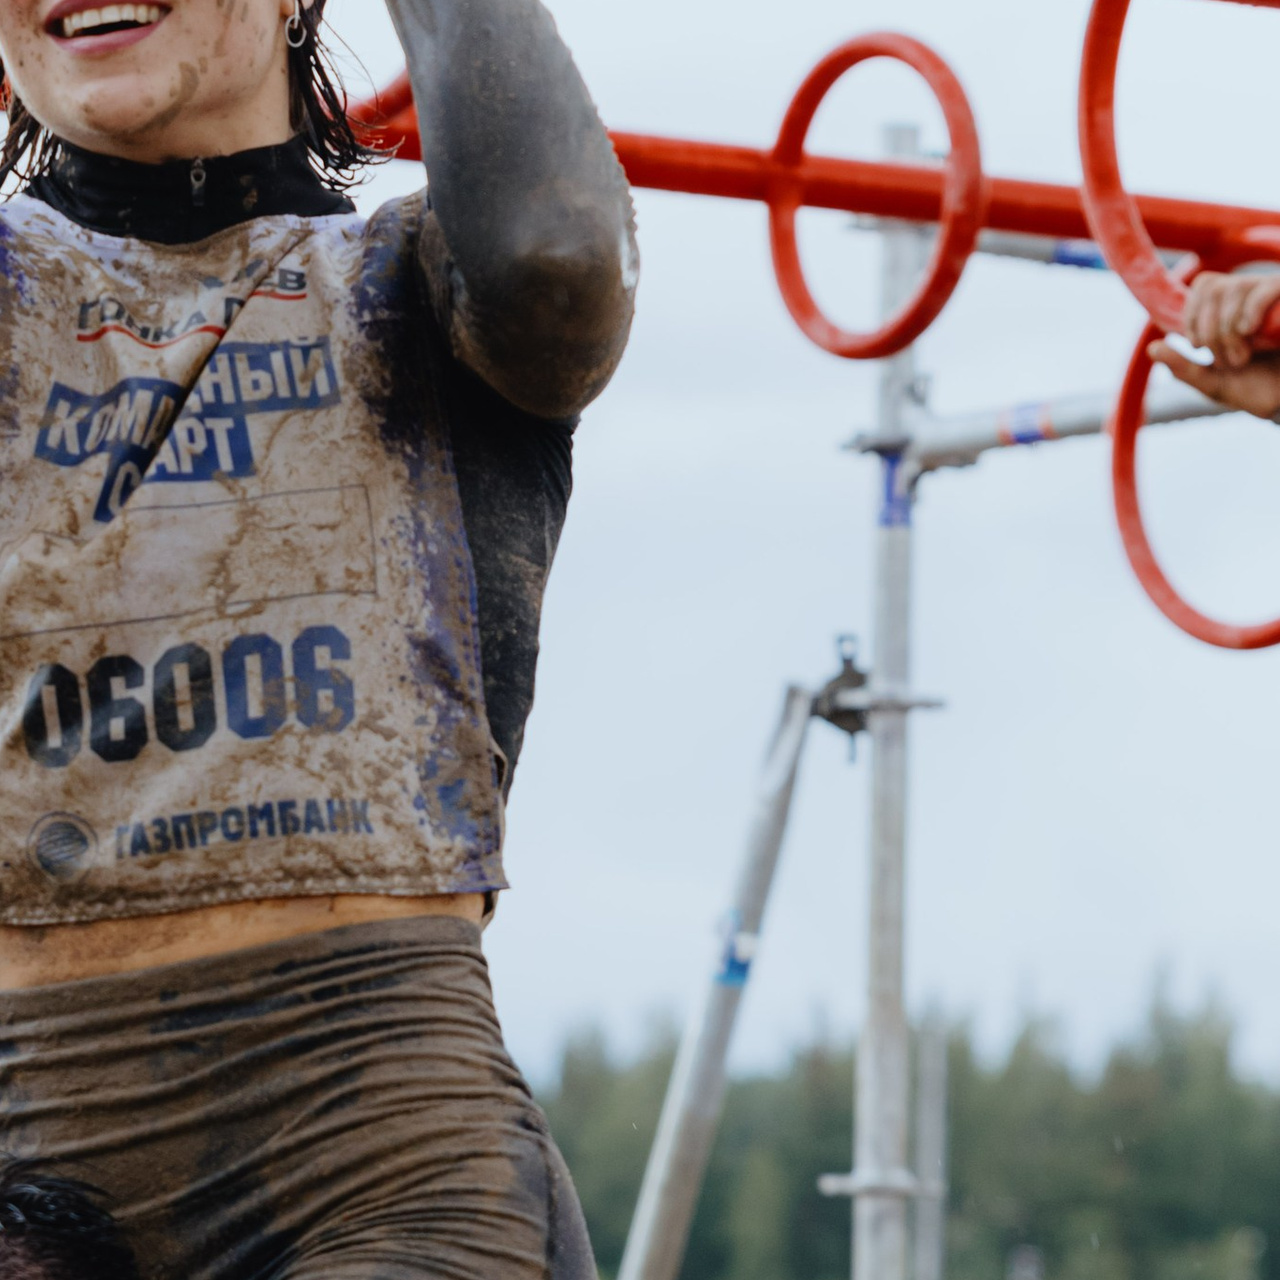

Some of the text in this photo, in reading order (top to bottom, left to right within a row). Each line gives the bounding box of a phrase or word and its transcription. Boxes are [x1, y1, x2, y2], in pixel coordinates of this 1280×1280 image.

[46, 334, 331, 456] КОМАНЫЙ
[107, 418, 235, 517] САРТ
[22, 624, 356, 768] 06006
[115, 798, 375, 860] ГАЗПРОМБАНК
